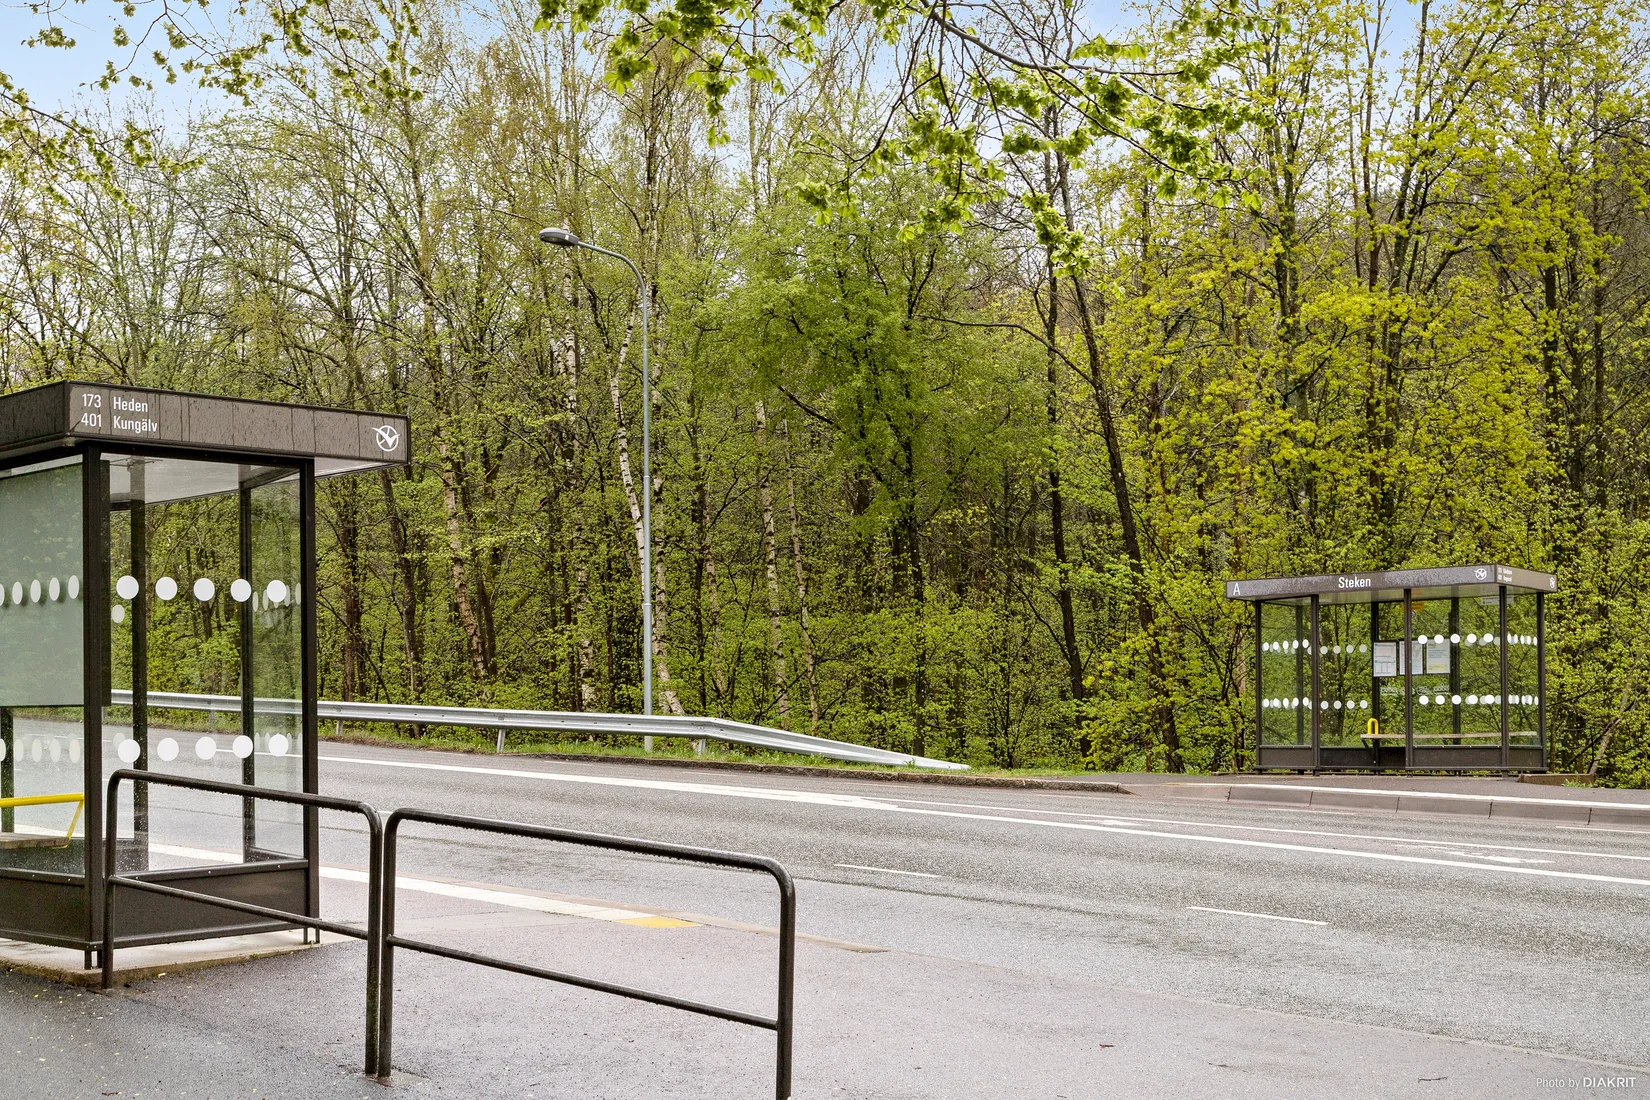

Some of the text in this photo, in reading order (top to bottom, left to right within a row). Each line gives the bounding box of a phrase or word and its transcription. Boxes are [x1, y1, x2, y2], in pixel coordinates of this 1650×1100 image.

[82, 393, 148, 412] 173 Heden
[80, 412, 158, 434] 401 Kungälv
[1233, 582, 1241, 596] A
[1338, 576, 1371, 589] Steken
